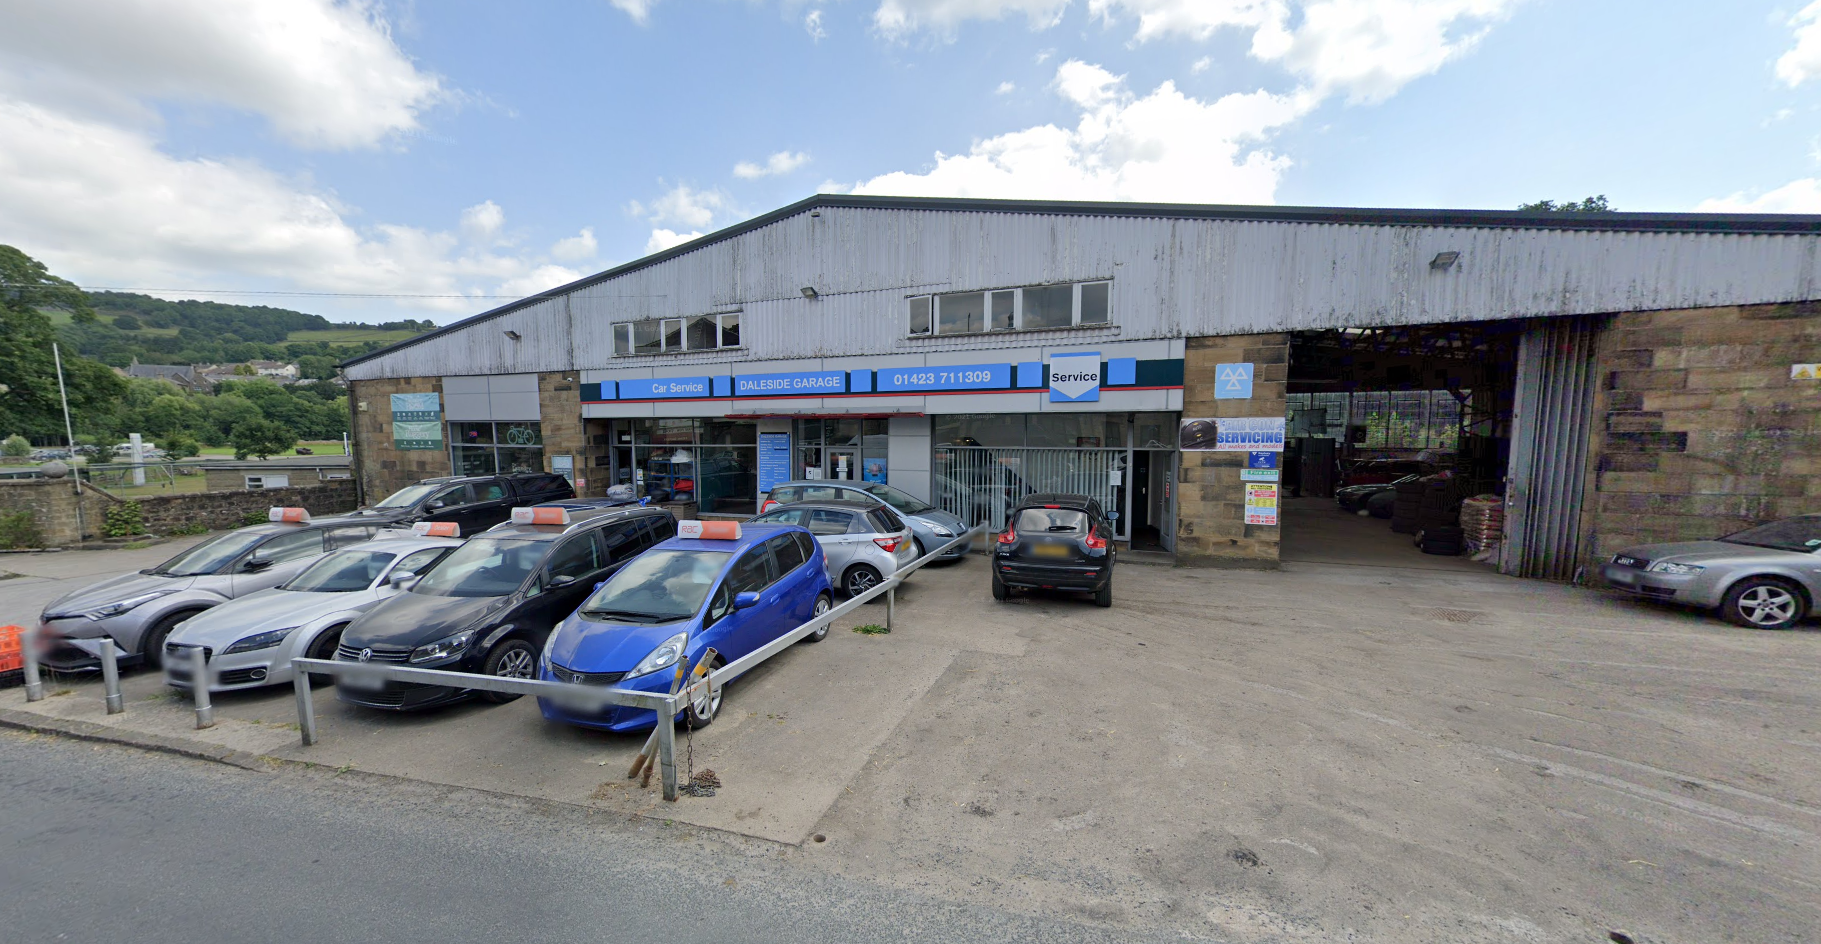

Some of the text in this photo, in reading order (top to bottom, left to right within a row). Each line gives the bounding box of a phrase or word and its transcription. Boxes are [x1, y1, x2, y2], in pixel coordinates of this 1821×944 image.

[740, 376, 840, 390] DALESIDE GARAGE
[893, 370, 991, 385] 01423 711309
[1051, 372, 1098, 382] Service
[652, 381, 703, 393] Car Service
[1225, 418, 1275, 431] AIR CON
[1217, 431, 1283, 443] SERVICING
